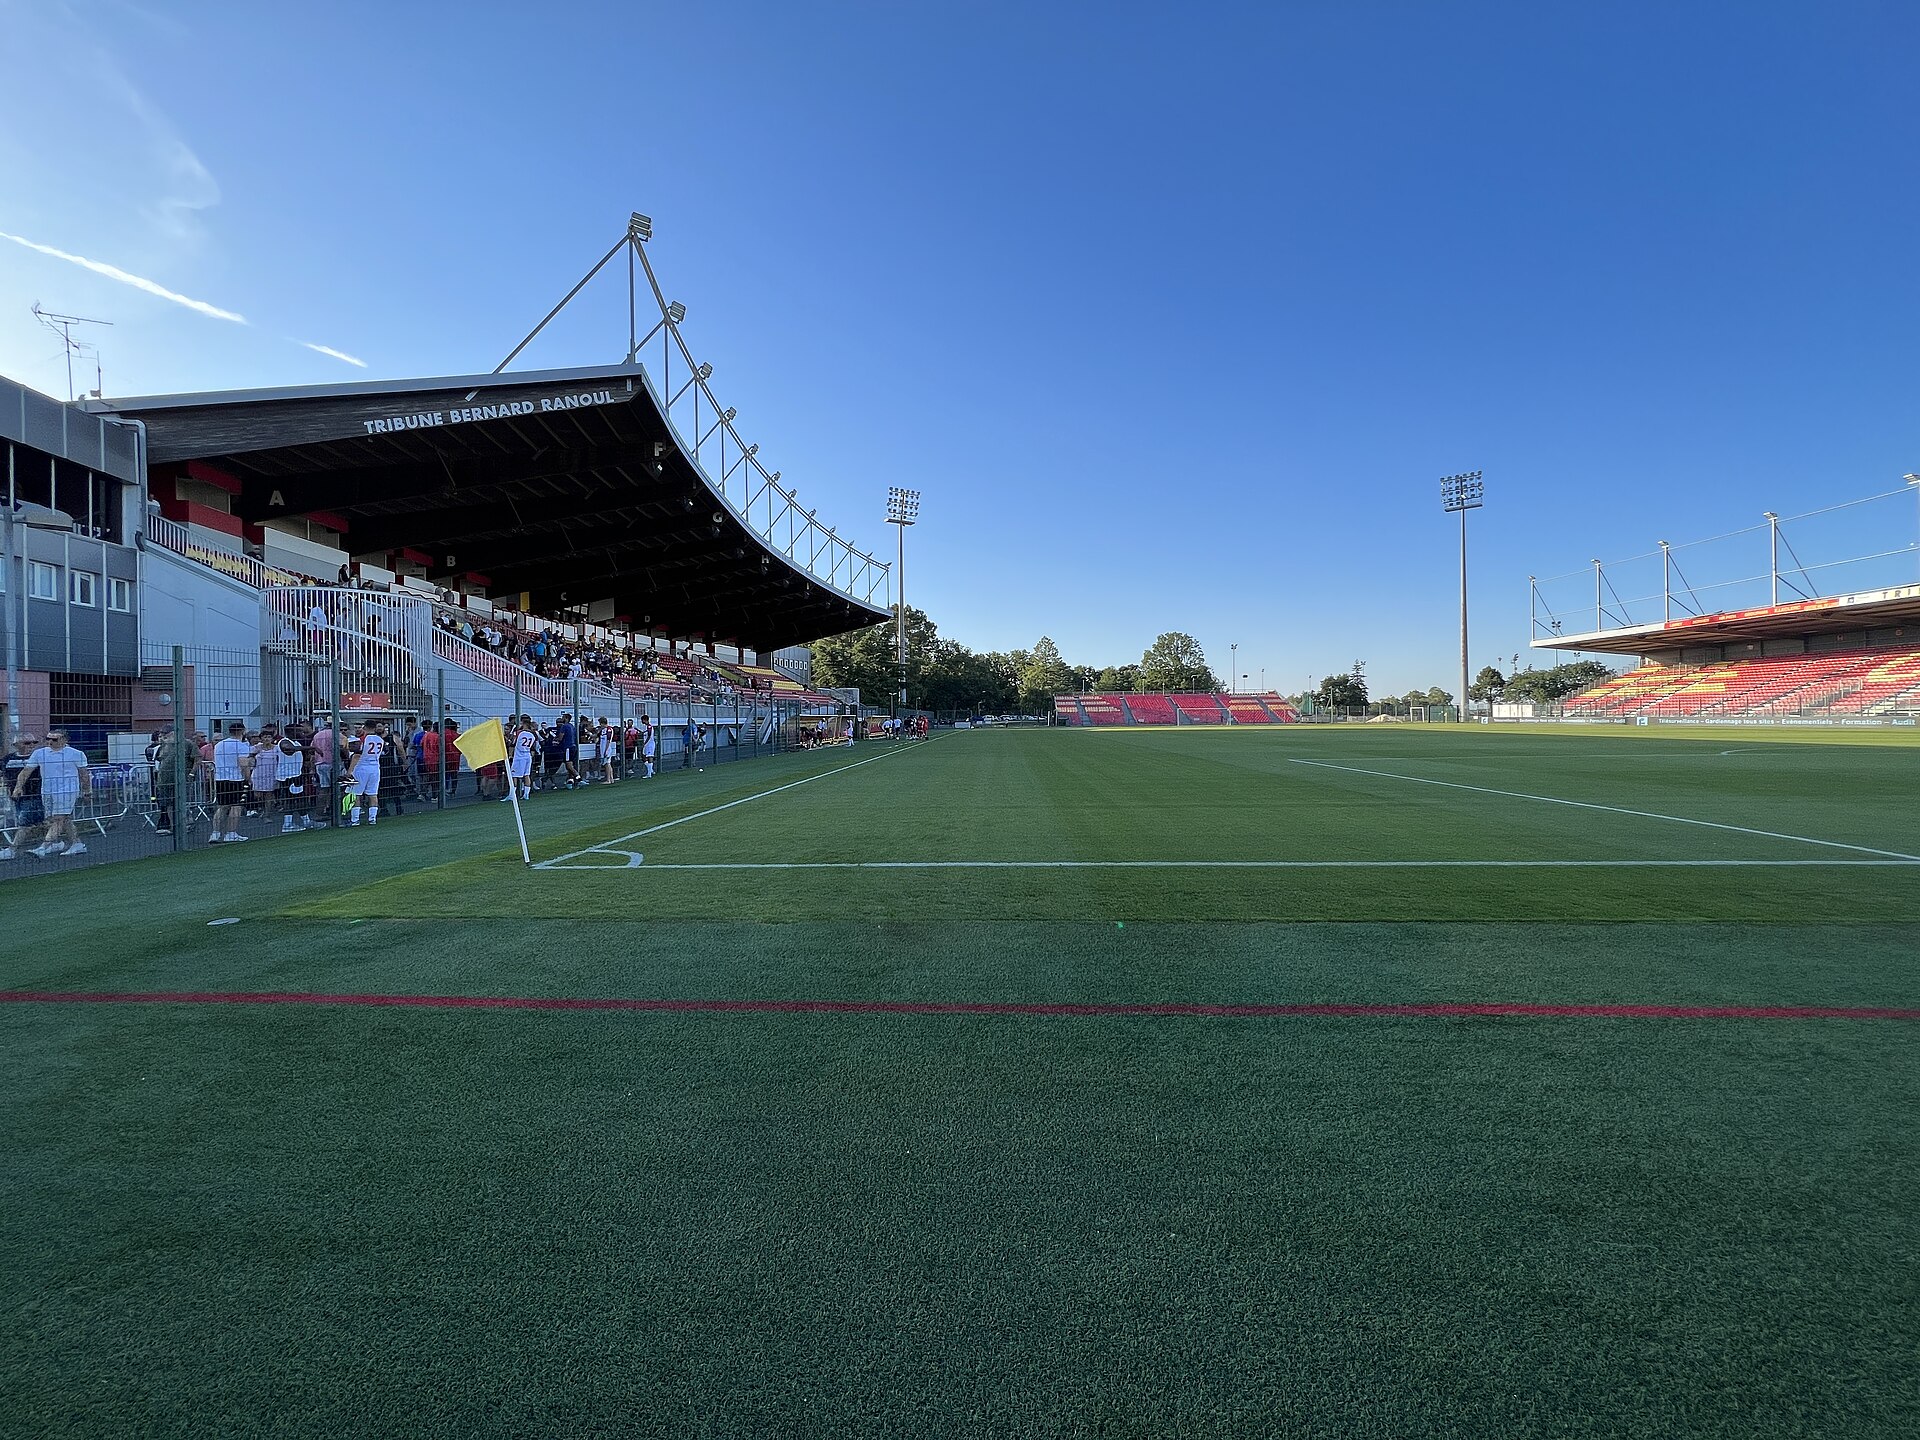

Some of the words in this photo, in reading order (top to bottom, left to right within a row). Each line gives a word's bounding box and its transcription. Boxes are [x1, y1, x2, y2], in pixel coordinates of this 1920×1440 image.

[364, 412, 443, 434] TRIBUNE
[450, 402, 535, 424] BERNARD
[541, 390, 615, 411] RANOUL
[654, 442, 663, 457] F
[269, 489, 285, 506] A
[712, 511, 723, 523] G
[446, 555, 456, 567] B
[761, 554, 770, 564] H
[560, 592, 567, 601] C
[1882, 587, 1920, 600] TRI
[644, 615, 651, 623] D
[1705, 718, 1742, 726] Gardiennage
[1758, 718, 1775, 726] sites
[1841, 718, 1883, 726] Formation
[1891, 718, 1916, 727] Audit
[367, 742, 383, 755] 23
